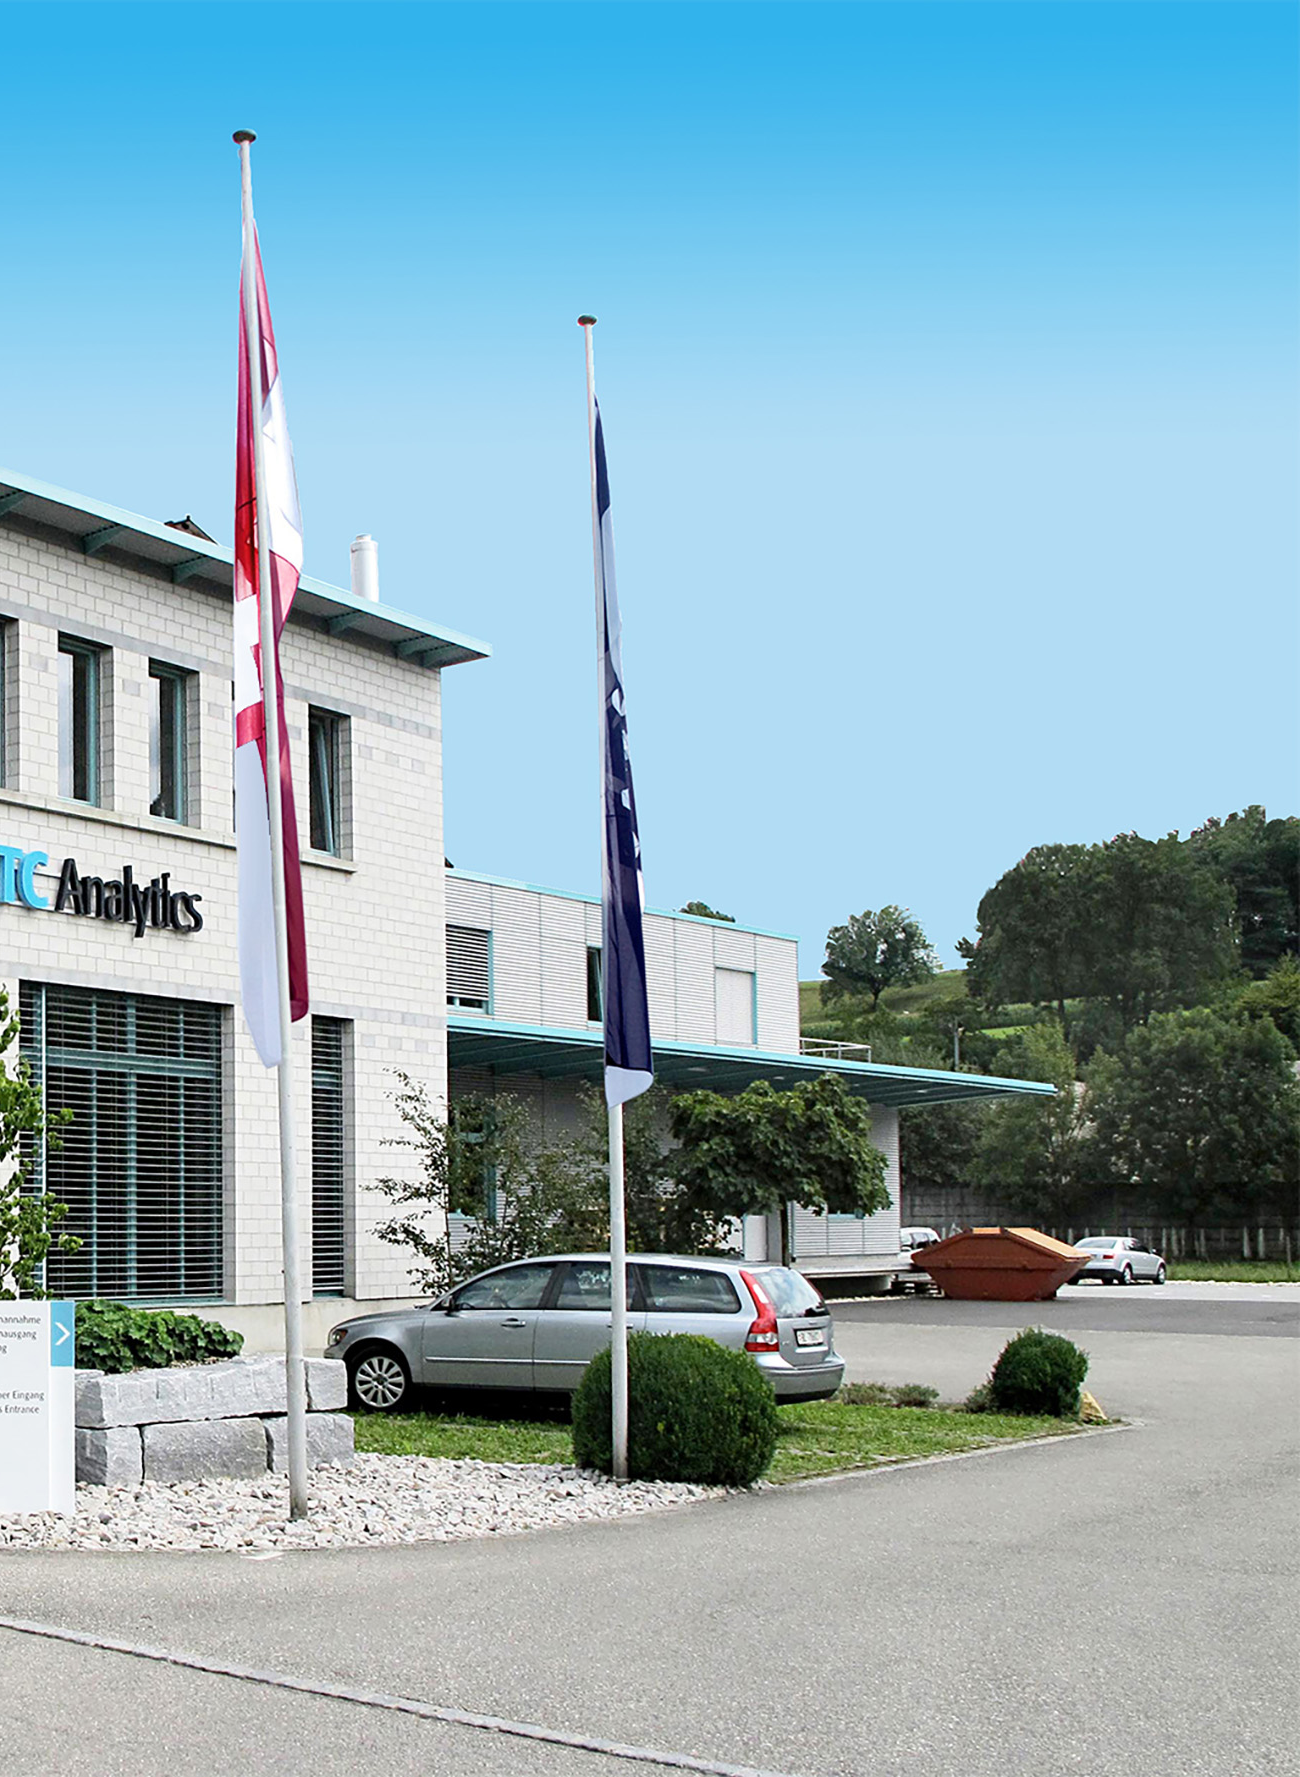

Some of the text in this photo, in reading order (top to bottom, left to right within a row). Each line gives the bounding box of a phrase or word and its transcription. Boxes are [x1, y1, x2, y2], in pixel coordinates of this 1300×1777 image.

[54, 858, 203, 938] Analytics
[12, 1390, 45, 1401] Eingang
[4, 1404, 40, 1413] Entrance
